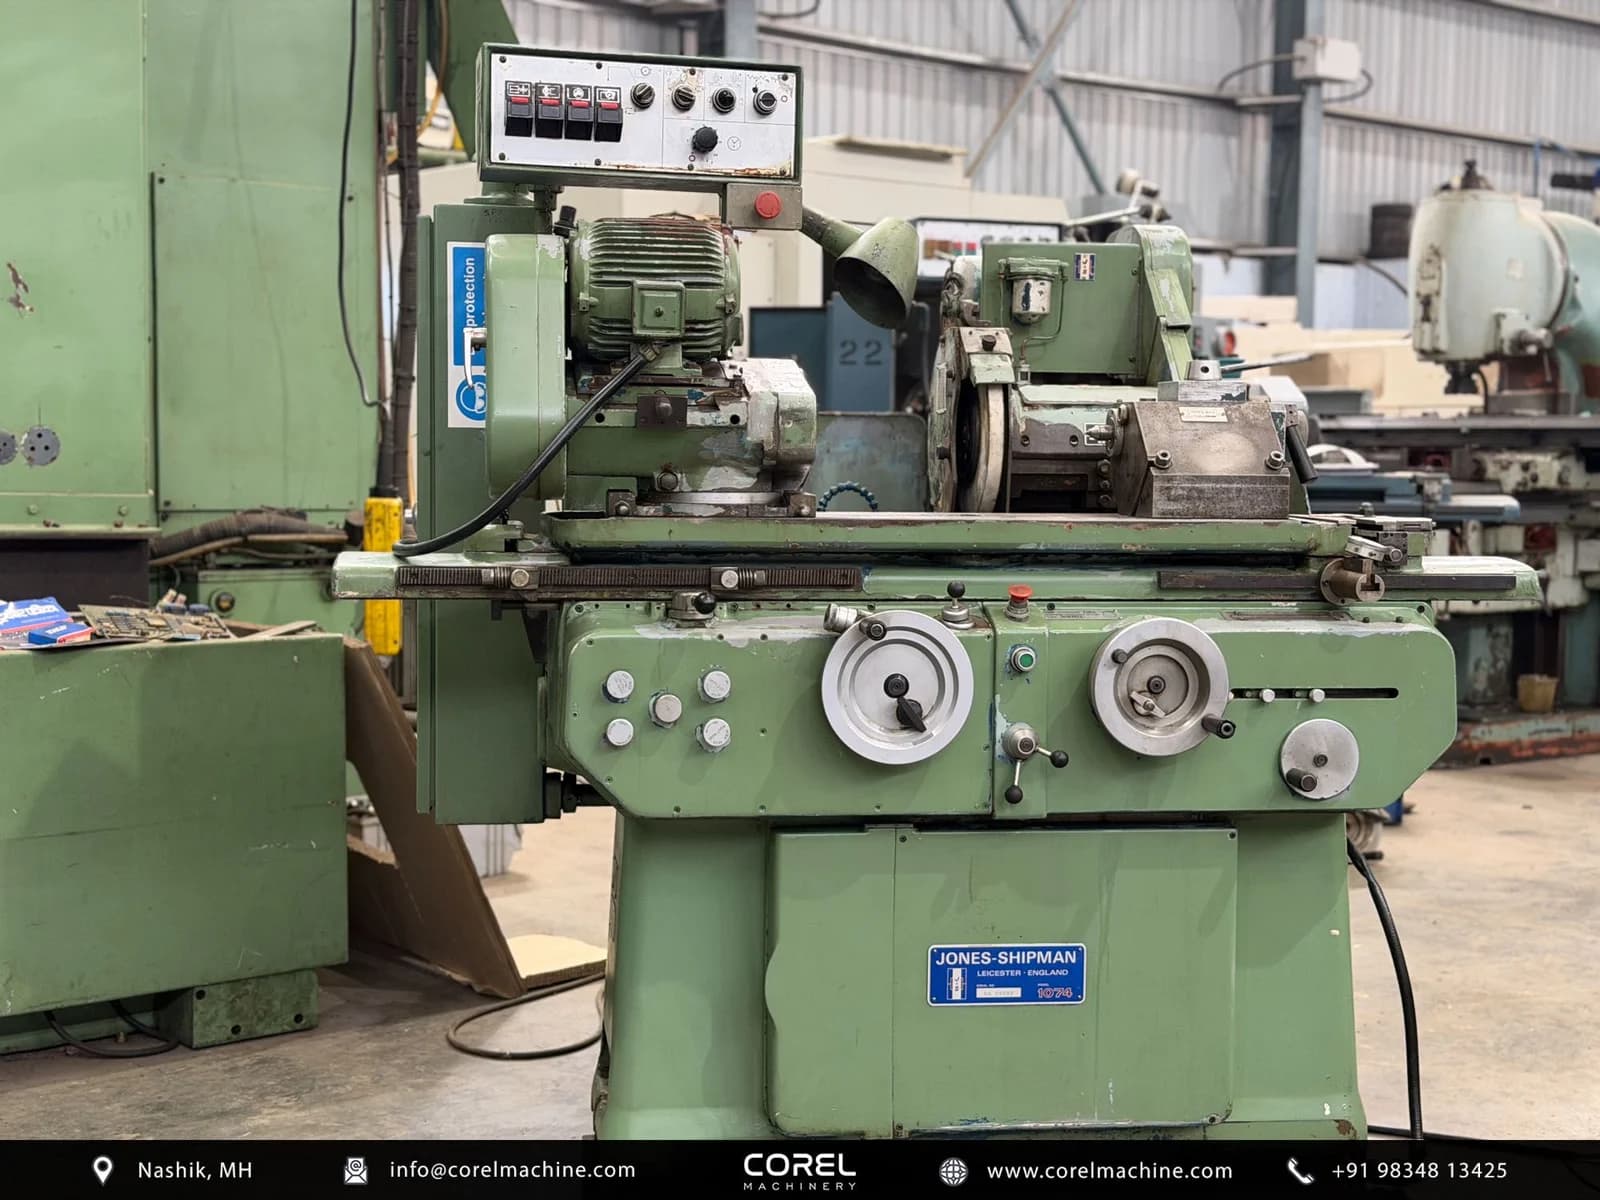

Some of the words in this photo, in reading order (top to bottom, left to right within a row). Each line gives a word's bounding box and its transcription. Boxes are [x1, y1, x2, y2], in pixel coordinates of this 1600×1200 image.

[463, 257, 478, 327] protection
[840, 339, 882, 366] 22
[935, 950, 1077, 966] JONES-SHIPMAN
[977, 969, 1021, 977] LEICESTER
[1027, 968, 1069, 977] ENGLAND
[1037, 986, 1073, 999] 1074
